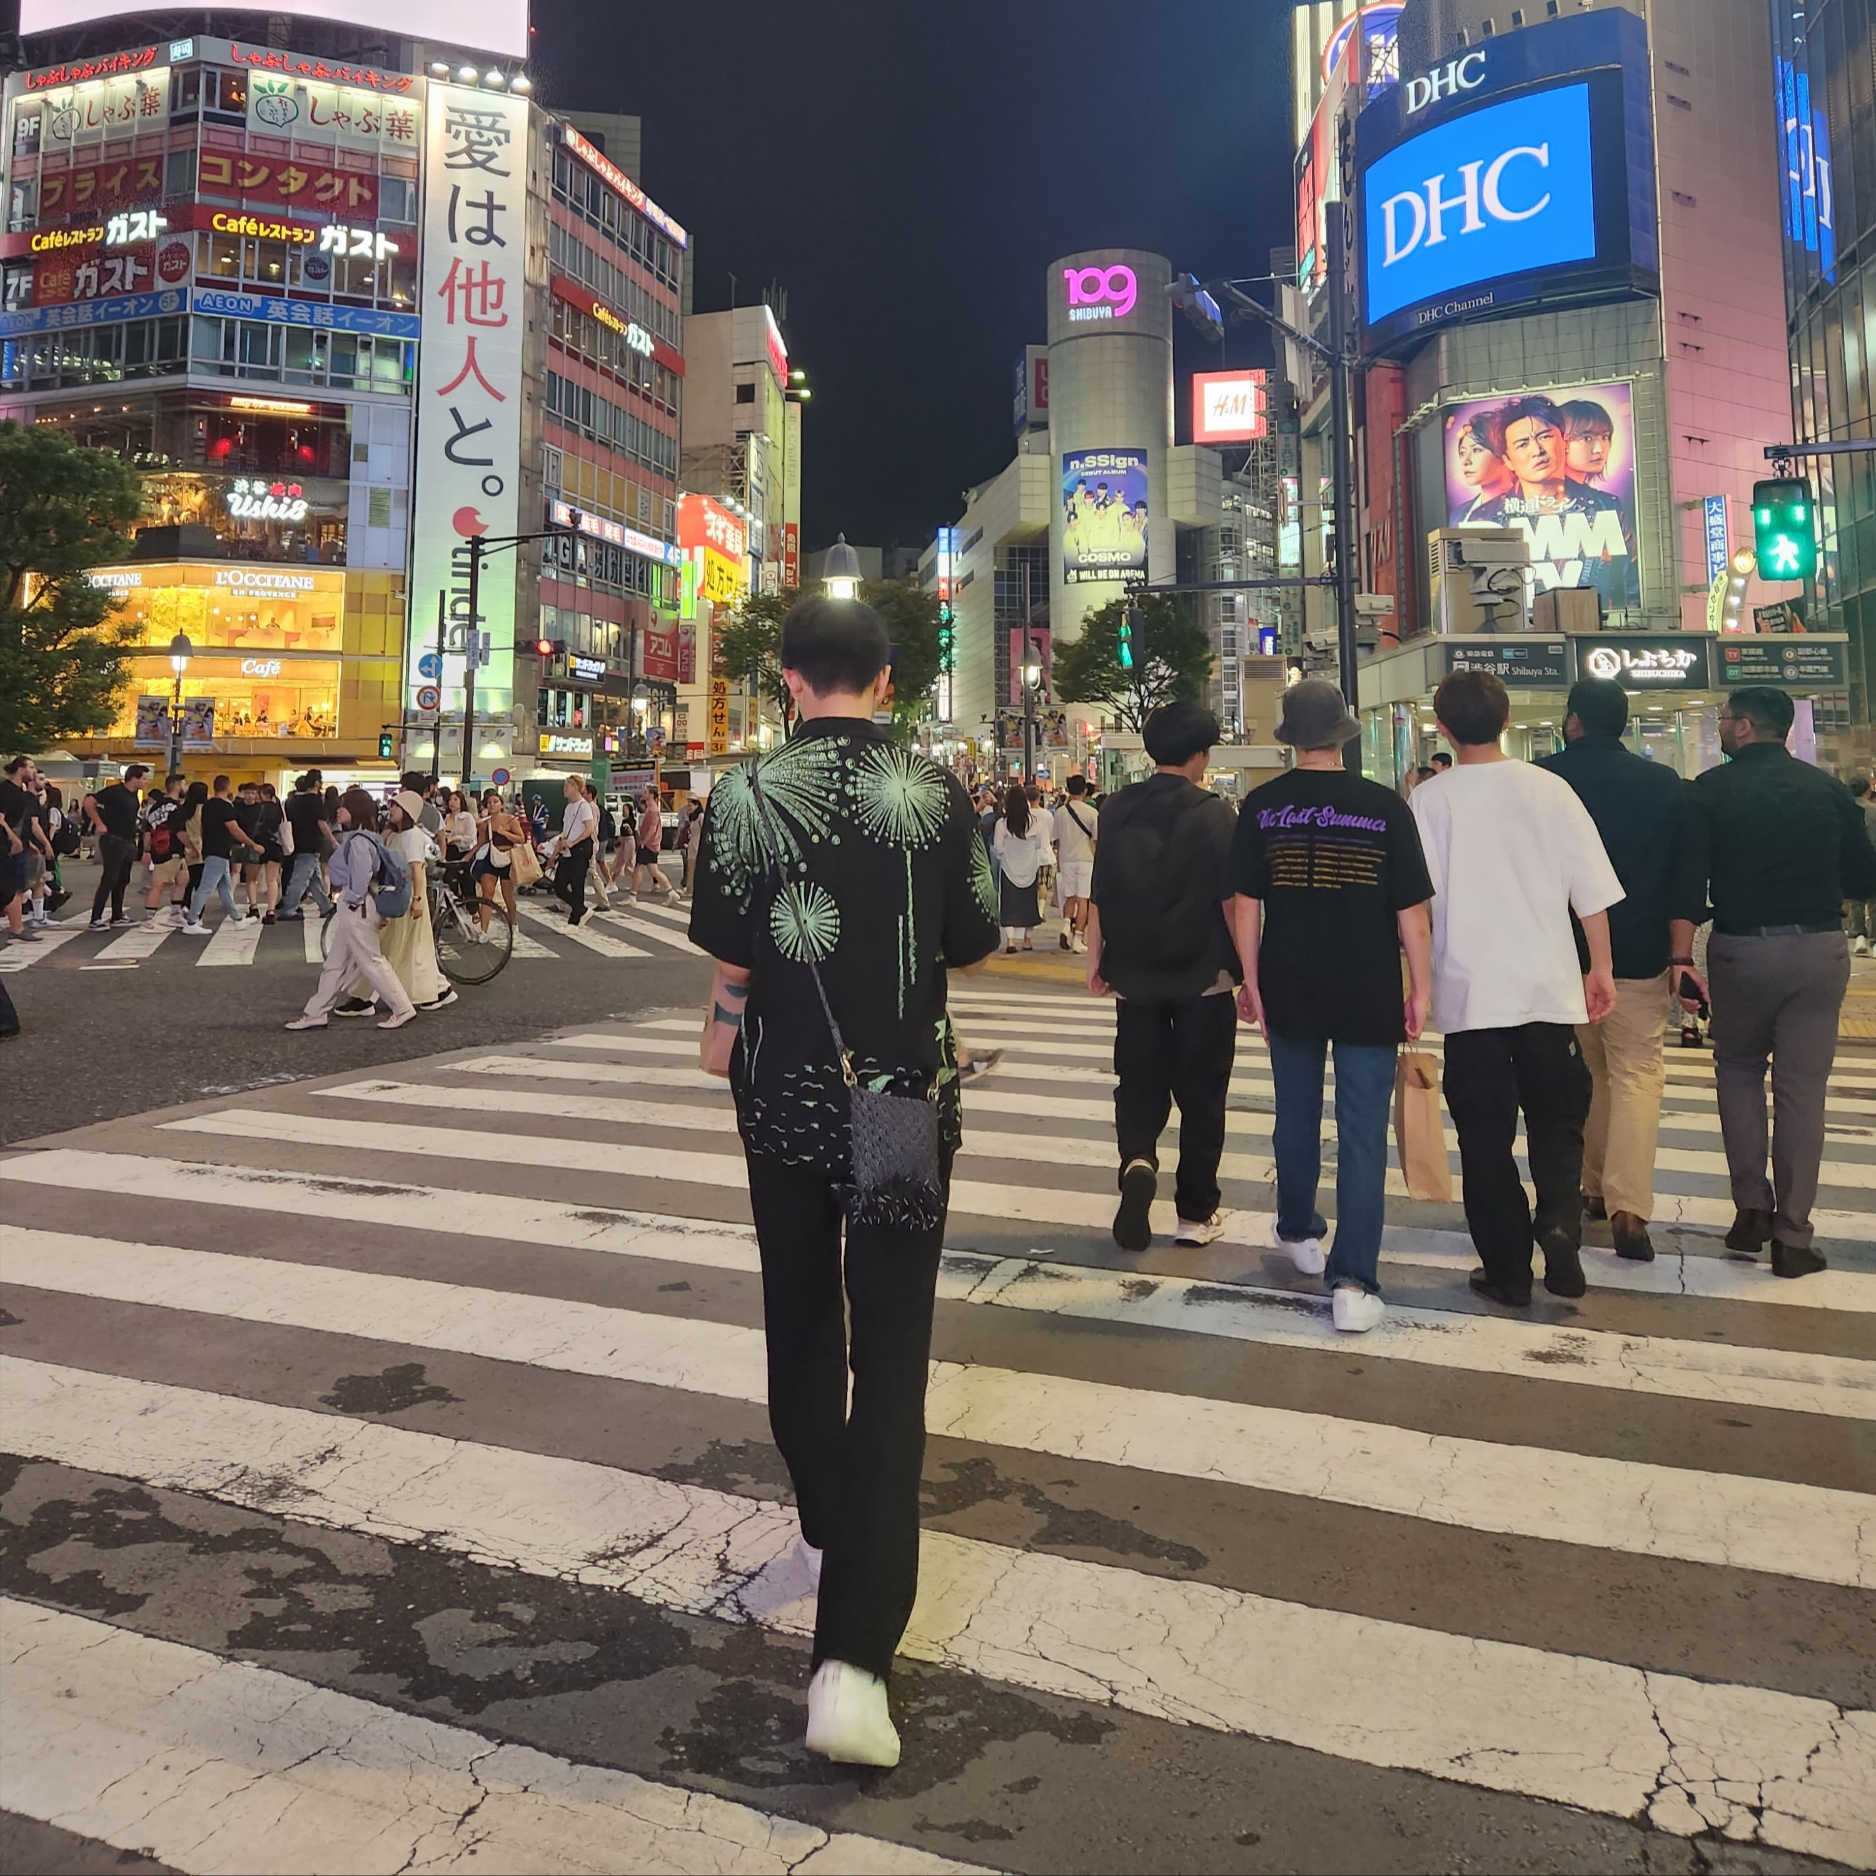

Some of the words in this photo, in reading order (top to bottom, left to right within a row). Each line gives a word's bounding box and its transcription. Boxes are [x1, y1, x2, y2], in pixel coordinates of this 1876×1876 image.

[25, 46, 158, 89] しゃぶしゃぶバイキング
[231, 44, 414, 93] しゃぶしゃぶバイキング
[1406, 51, 1486, 115] DHC
[87, 86, 161, 127] しゃぶ葉
[310, 95, 415, 140] しゃぶ葉
[17, 116, 40, 137] 9F
[42, 161, 160, 208] プライス
[200, 156, 373, 206] コンタクト
[1380, 142, 1551, 269] DHC
[106, 210, 168, 246] ガスト
[319, 225, 399, 260] ガスト
[6, 276, 32, 299] 7F
[74, 256, 147, 299] ガスト
[1064, 264, 1137, 318] 109
[202, 293, 252, 312] AEON
[266, 300, 415, 334] 英会話イーオン
[437, 105, 511, 497] 愛は他人と。
[1069, 306, 1112, 321] SHIBUYA
[1418, 307, 1443, 325] DHC
[1444, 292, 1494, 317] Channel
[627, 322, 655, 357] ガスト
[1212, 394, 1248, 417] H&M
[1078, 552, 1132, 563] COSMO
[1079, 570, 1097, 580] WILL
[1098, 569, 1108, 580] BE
[1108, 569, 1120, 579] ON
[215, 569, 314, 590] L'OCCITANE
[248, 590, 297, 598] PROVENCE
[650, 635, 672, 657] アコム
[1621, 649, 1697, 668] しぶちか
[242, 659, 281, 677] Café
[1470, 662, 1510, 675] 渋谷駅
[1511, 667, 1542, 677] Shibuya
[1544, 667, 1560, 675] Sta.
[712, 681, 726, 738] 処方せん
[1277, 804, 1317, 829] Last
